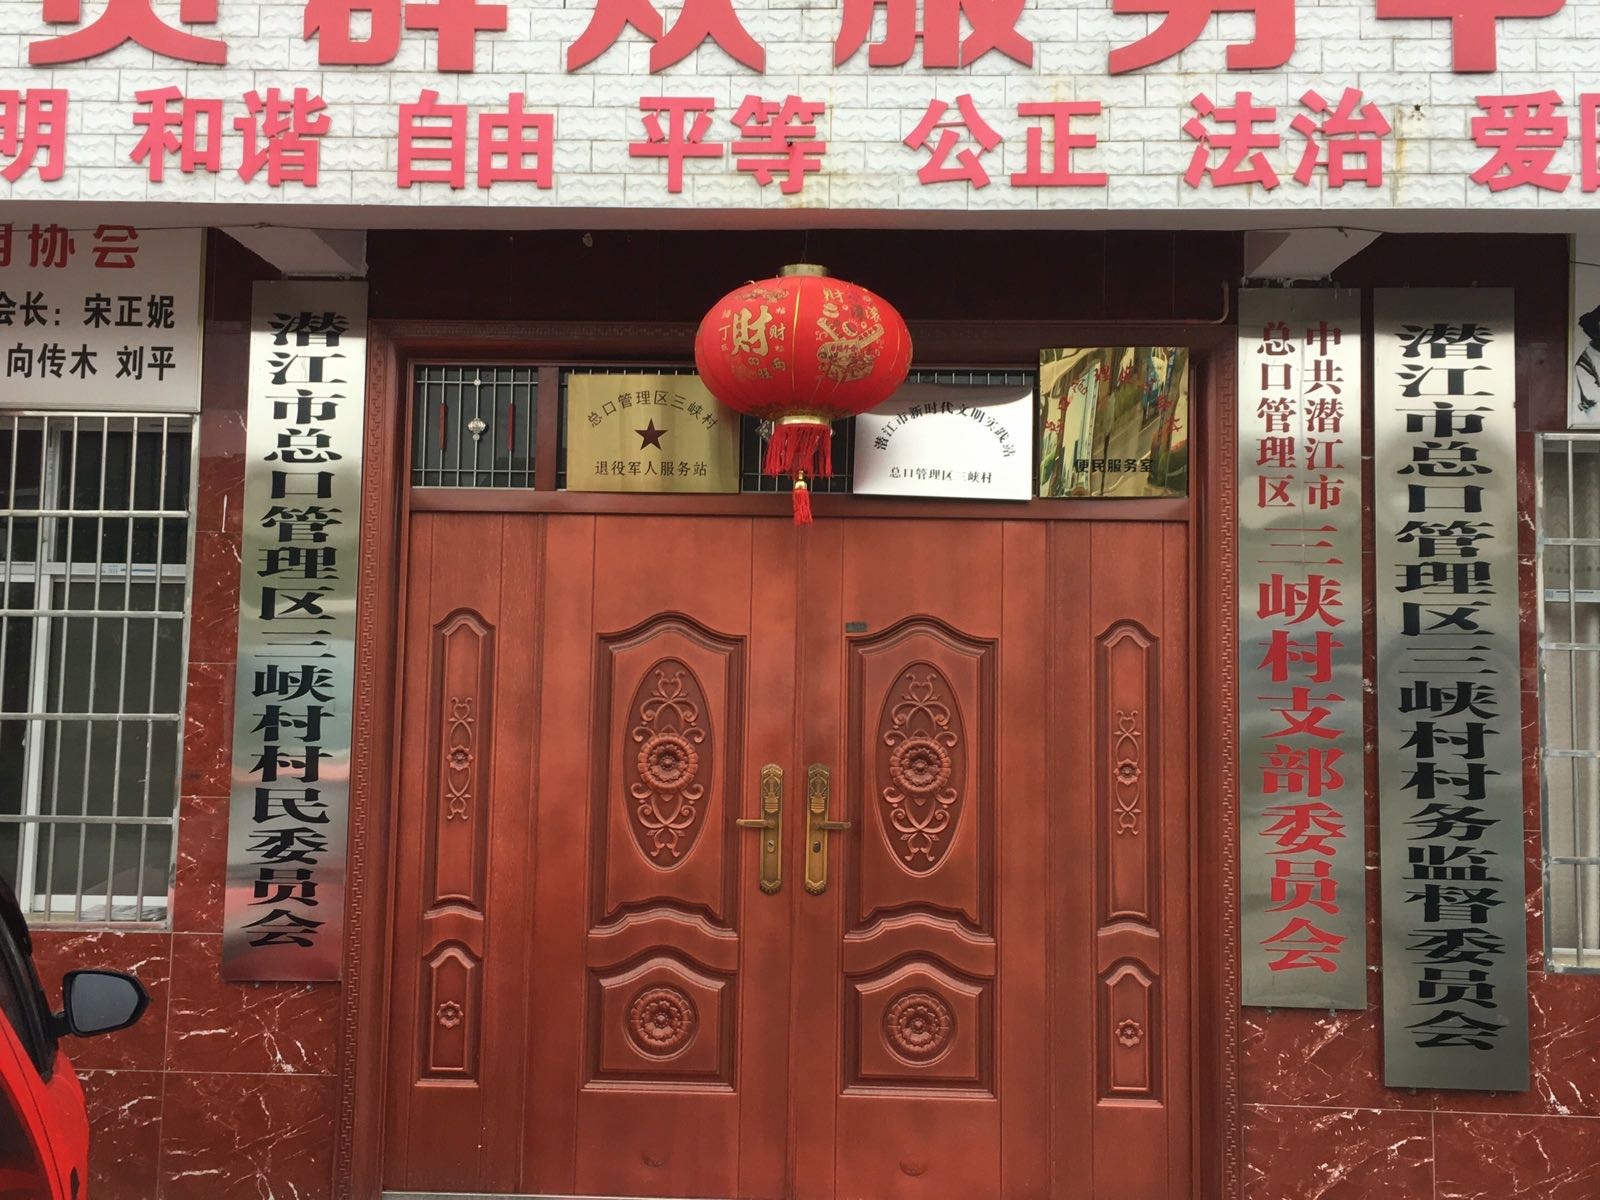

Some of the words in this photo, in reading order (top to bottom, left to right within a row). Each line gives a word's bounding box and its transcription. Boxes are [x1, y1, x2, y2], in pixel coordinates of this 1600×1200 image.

[131, 86, 331, 188] 和谐
[398, 89, 554, 190] 自由
[629, 95, 827, 195] 平等
[903, 94, 1107, 189] 公正
[1183, 87, 1391, 191] 法治
[1469, 90, 1600, 192] 爱
[6, 343, 98, 379] 向传木
[116, 346, 176, 381] 刘平
[586, 389, 720, 431] 总口管理区三峡村
[1256, 321, 1297, 509] 总口管理区
[1303, 320, 1345, 511] 中共潜江市
[594, 460, 708, 478] 退役军人服务站
[873, 401, 1017, 458] 潜江市新时代文明实践站
[1075, 458, 1154, 474] 便民服务室
[241, 311, 349, 948] 潜江市总口管理区三峡村村民委员会
[1394, 322, 1507, 1052] 潜江市总口管理区三峡村村务监督委员会
[1256, 525, 1348, 973] 三峡村支部委员会
